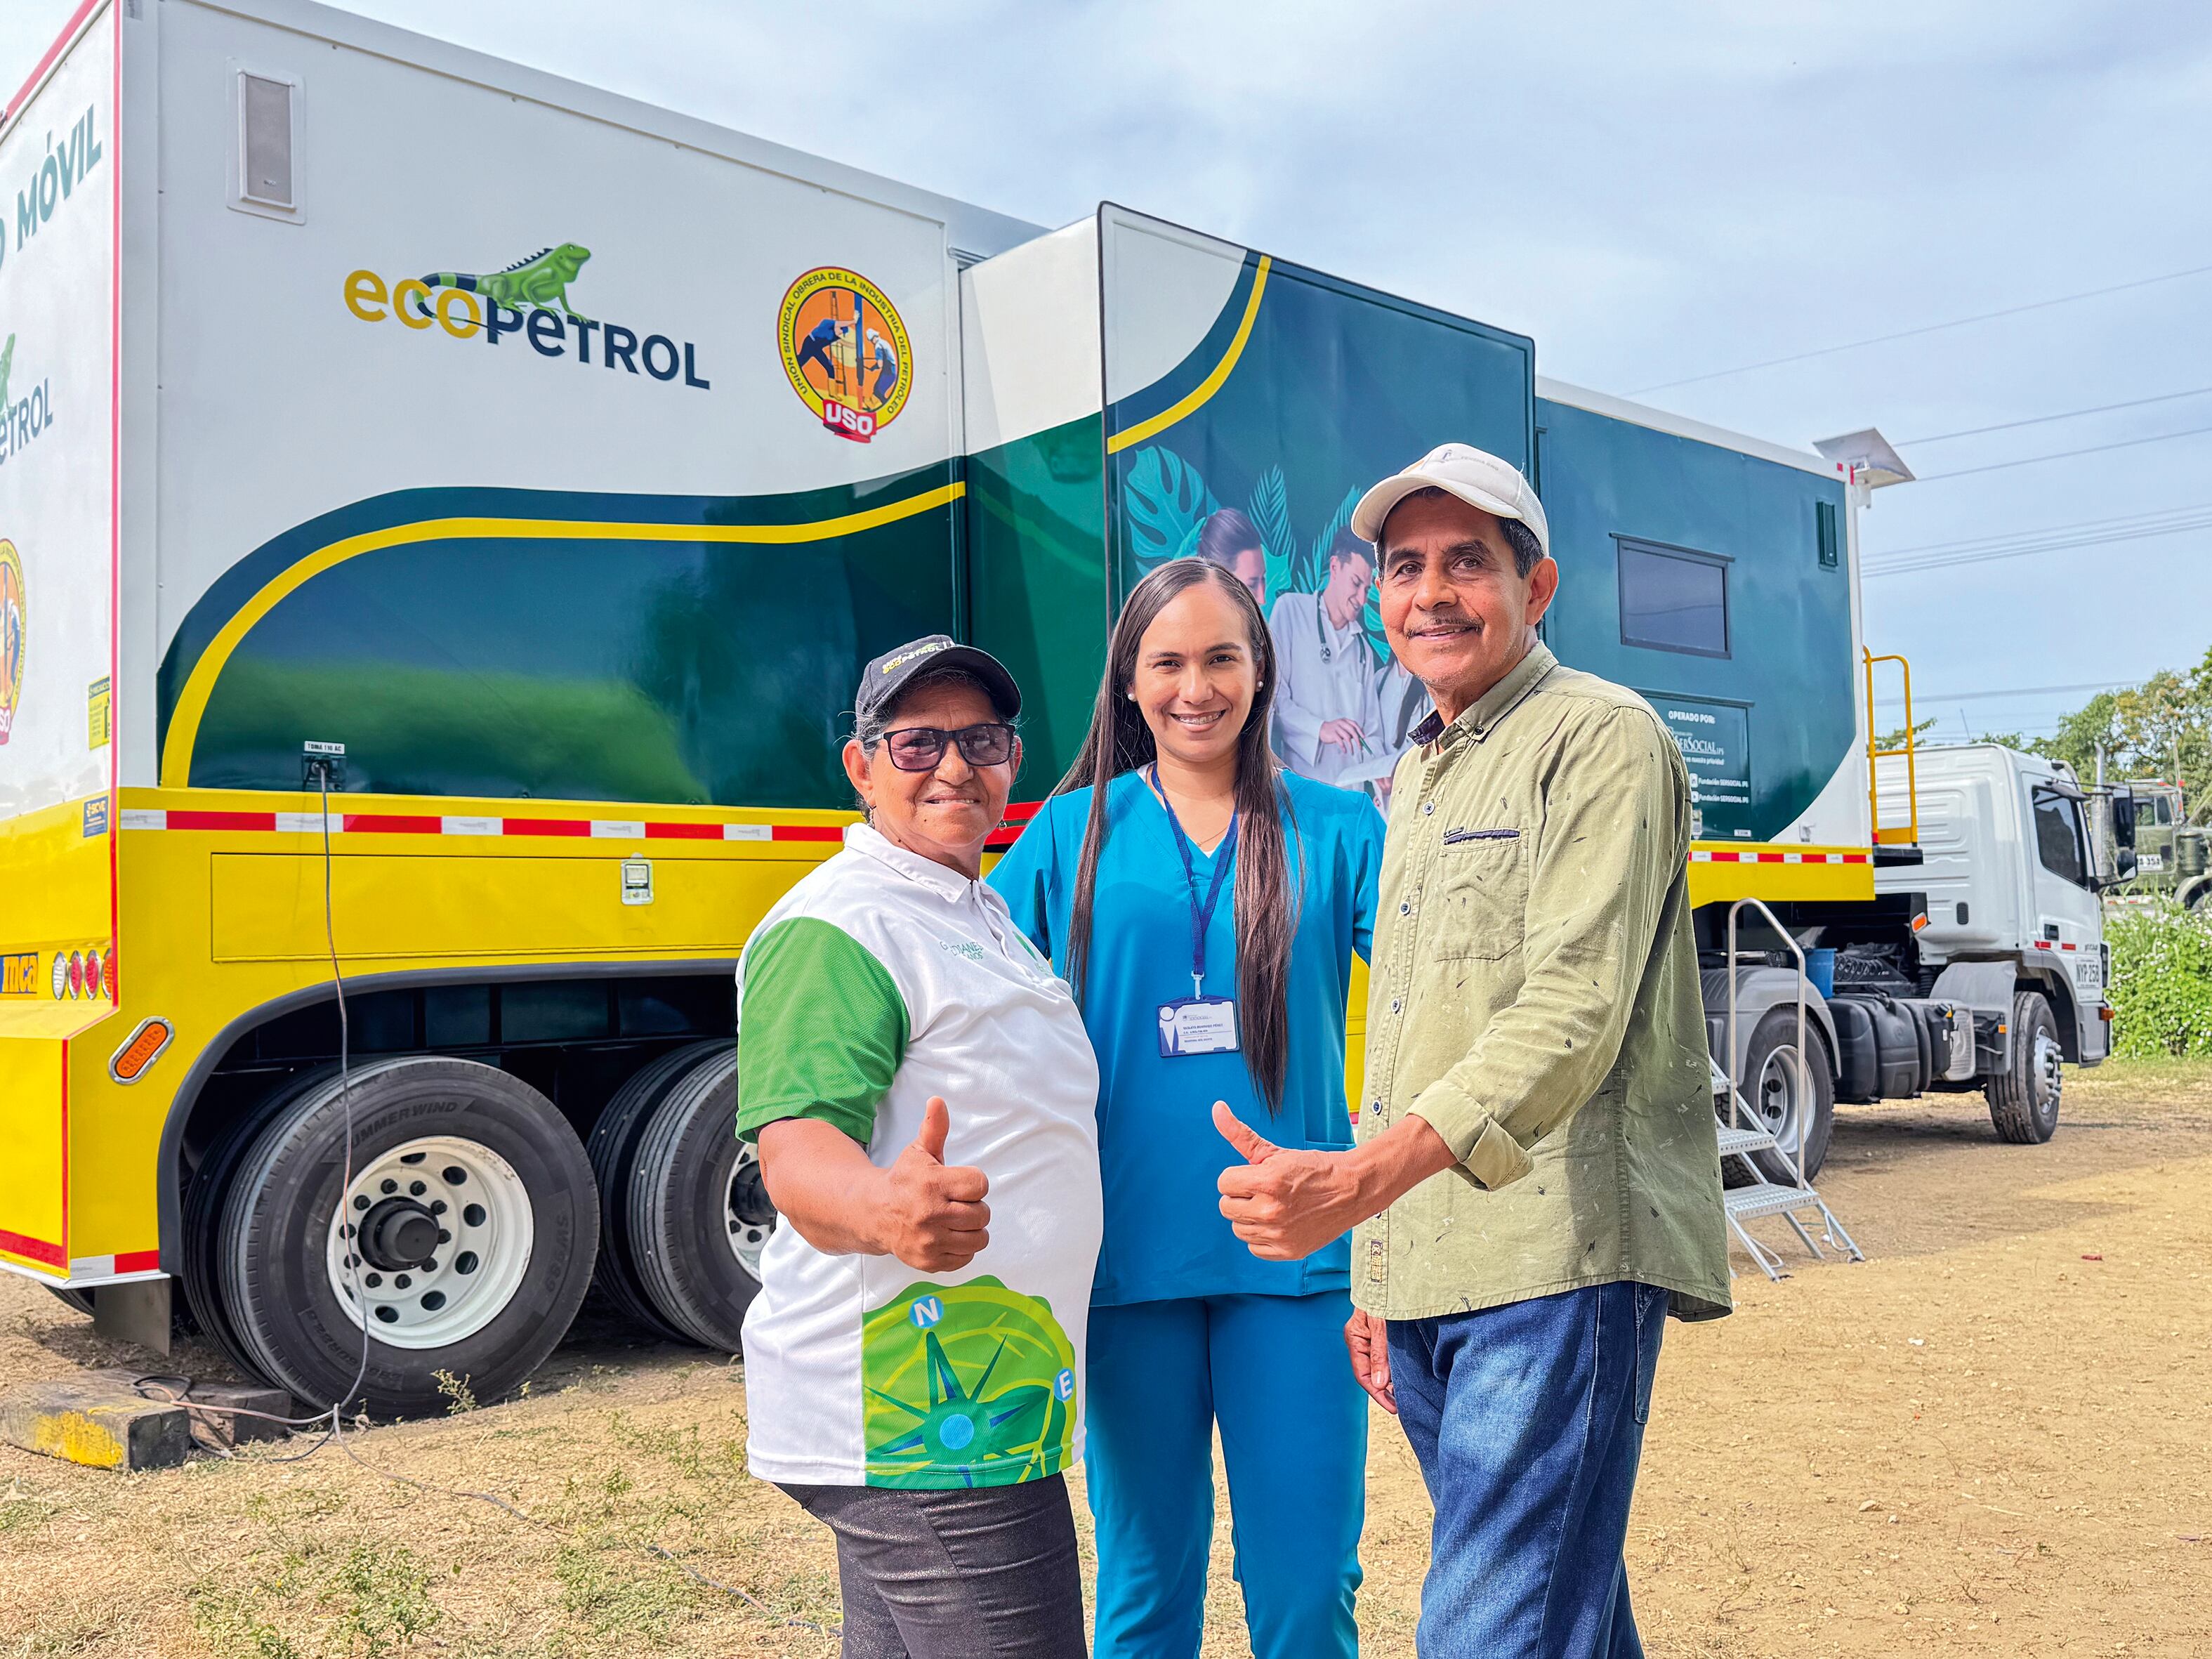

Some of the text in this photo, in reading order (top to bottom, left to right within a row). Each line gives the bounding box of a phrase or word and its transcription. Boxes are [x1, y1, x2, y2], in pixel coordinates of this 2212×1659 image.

[17, 103, 102, 252] MÓVIL
[782, 302, 796, 353] SINDICAL
[793, 273, 827, 299] OBRERA
[829, 272, 843, 281] DE
[845, 275, 857, 286] LA
[859, 282, 900, 334] INDUSTRIA
[898, 335, 907, 357] DEL
[826, 403, 873, 435] USO
[1668, 710, 1699, 722] OPERADO
[914, 1297, 940, 1327] N
[1059, 1370, 1072, 1396] E
